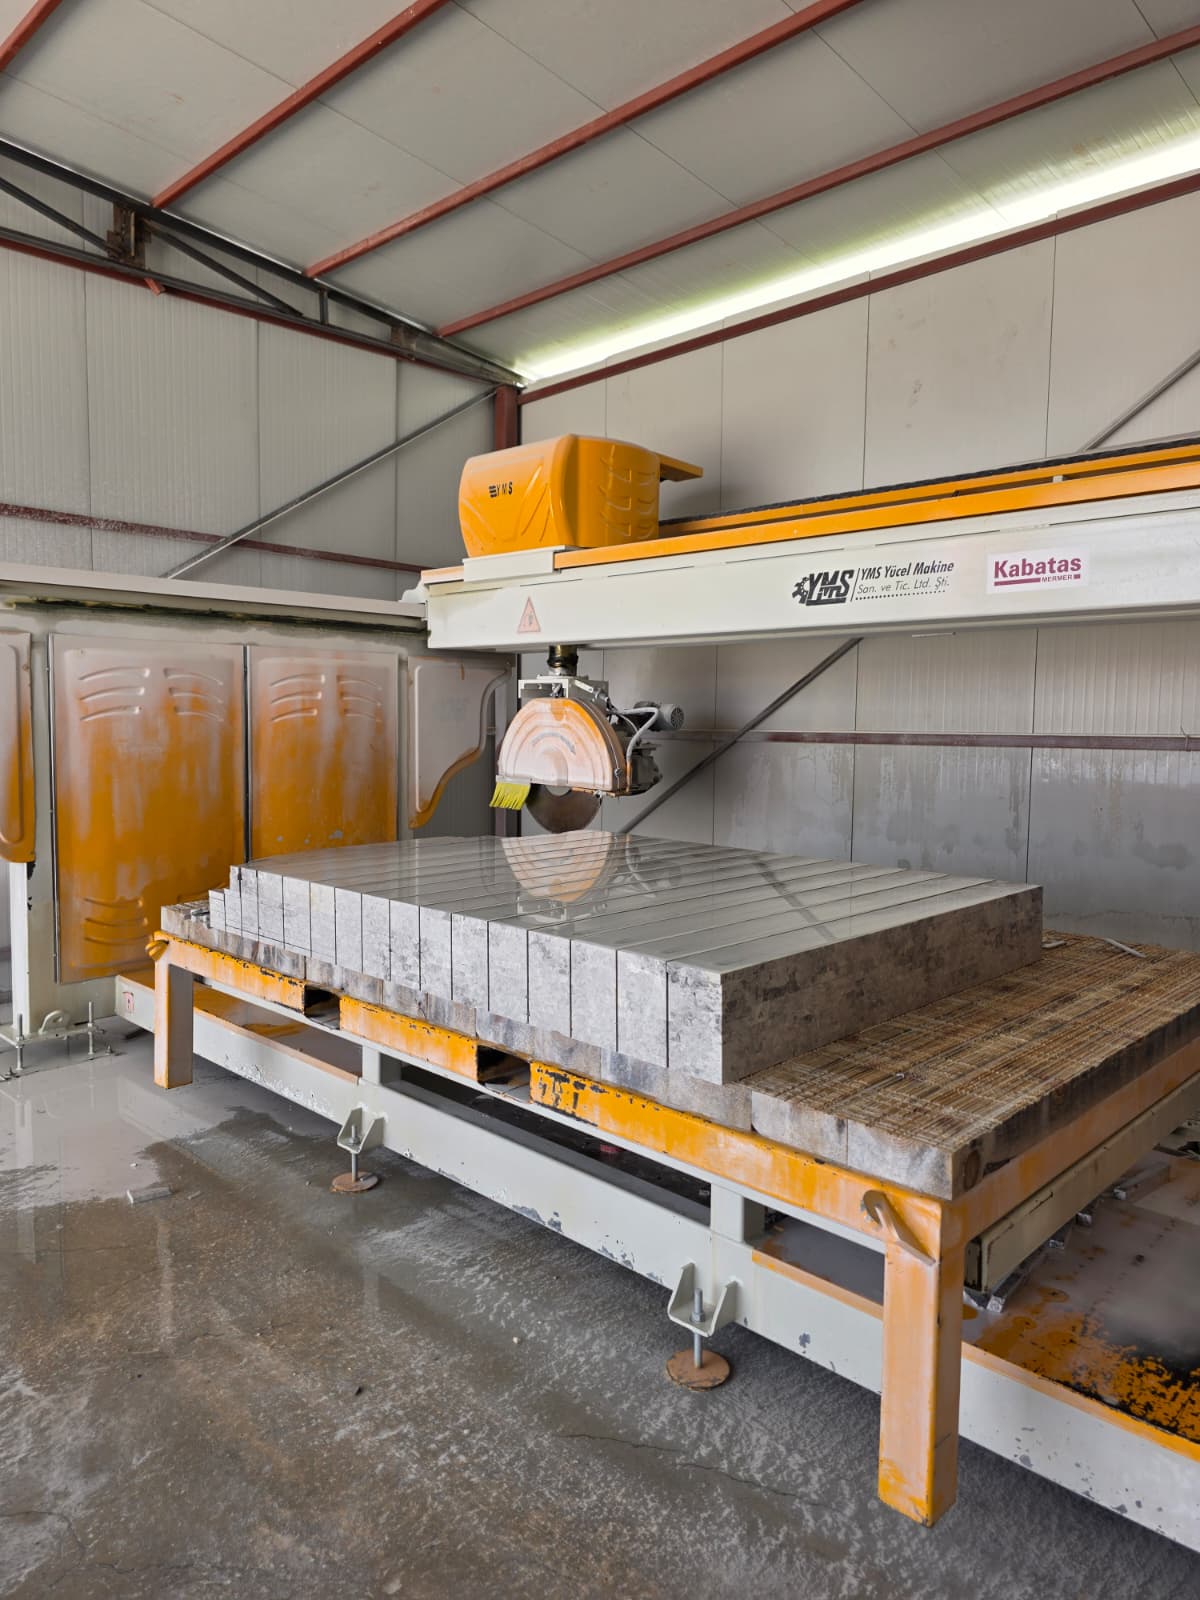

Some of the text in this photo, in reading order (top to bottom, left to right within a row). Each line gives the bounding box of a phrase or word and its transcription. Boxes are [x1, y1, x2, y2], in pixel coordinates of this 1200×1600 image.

[860, 560, 954, 580] YMS Yücel Makine
[994, 557, 1082, 579] Kabatas
[806, 569, 855, 603] YMS
[895, 581, 910, 591] Tic.
[914, 579, 931, 589] Ltd.
[935, 576, 950, 590] Şti.
[1041, 575, 1073, 583] MERMER
